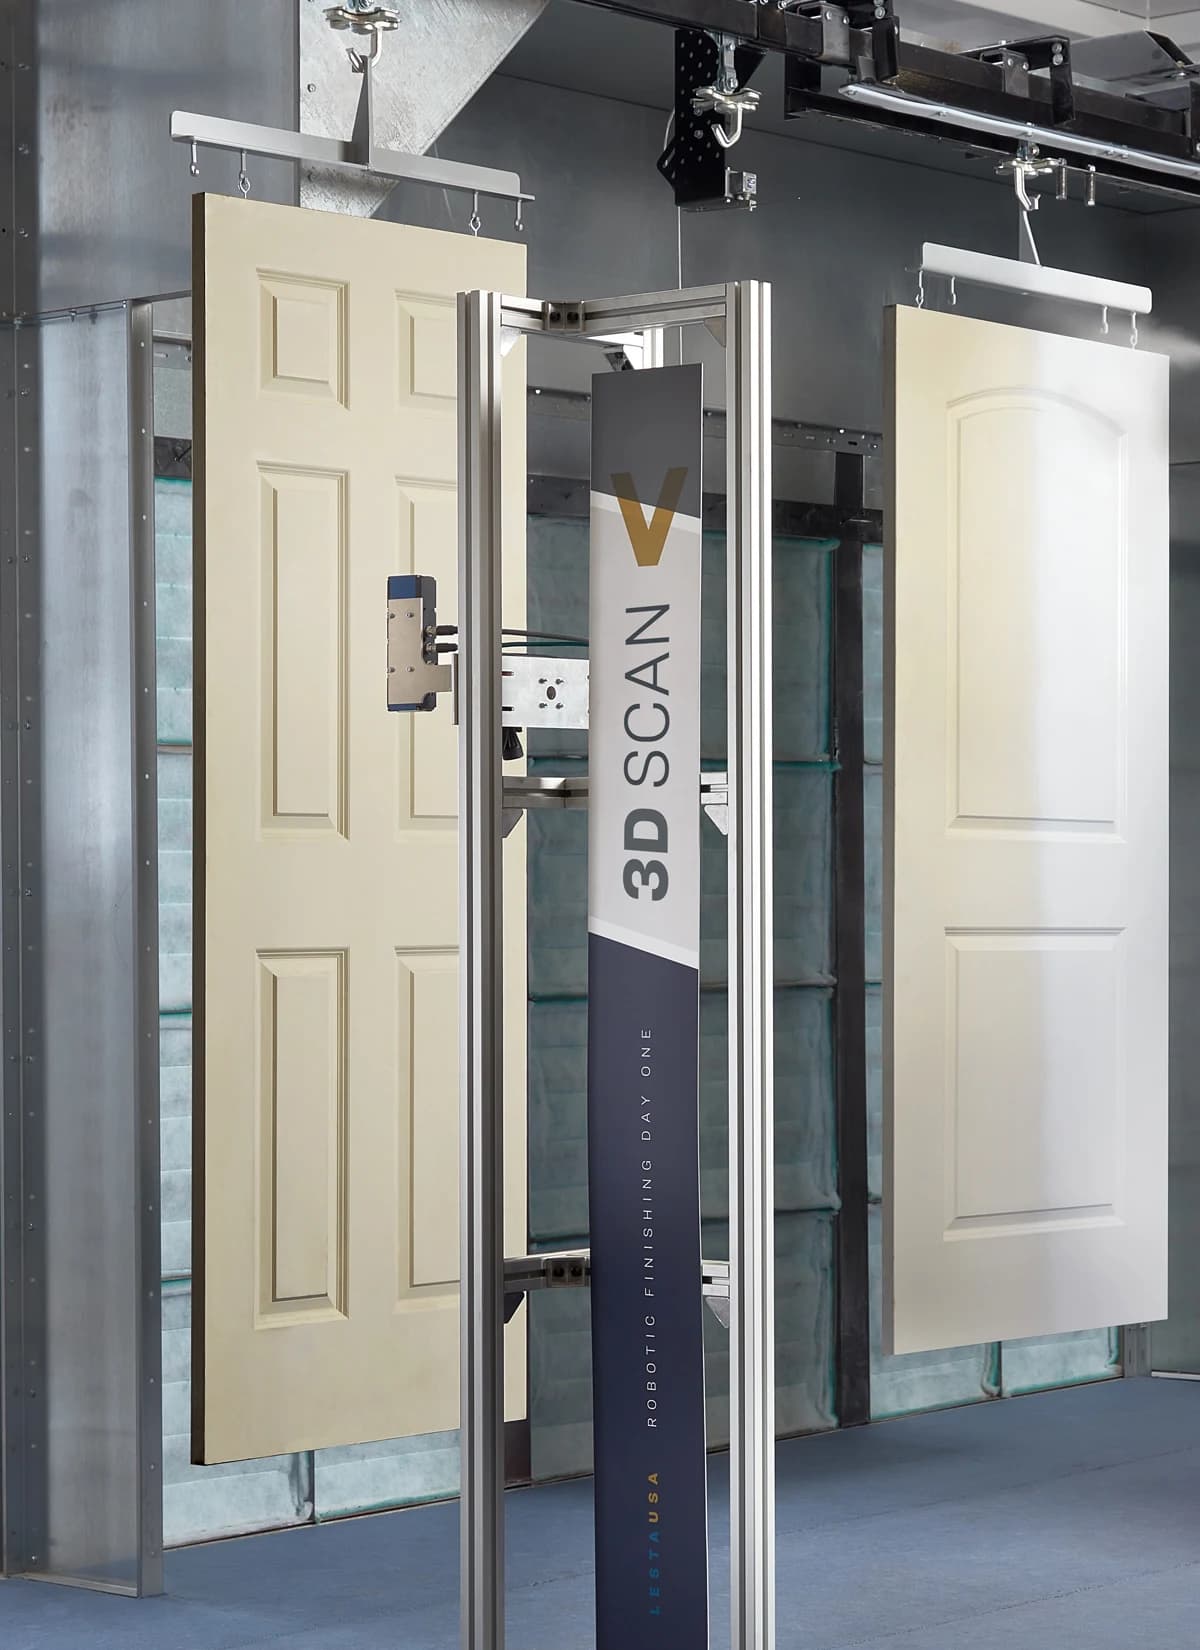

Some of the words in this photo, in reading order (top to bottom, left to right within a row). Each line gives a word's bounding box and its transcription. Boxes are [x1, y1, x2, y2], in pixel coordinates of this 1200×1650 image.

[611, 467, 688, 567] V
[623, 603, 671, 788] SCAN
[622, 807, 670, 903] 3D
[639, 1028, 652, 1078] ONE
[640, 1095, 652, 1142] DAY
[641, 1158, 655, 1298] FINISHING
[645, 1314, 658, 1428] ROBOTIC
